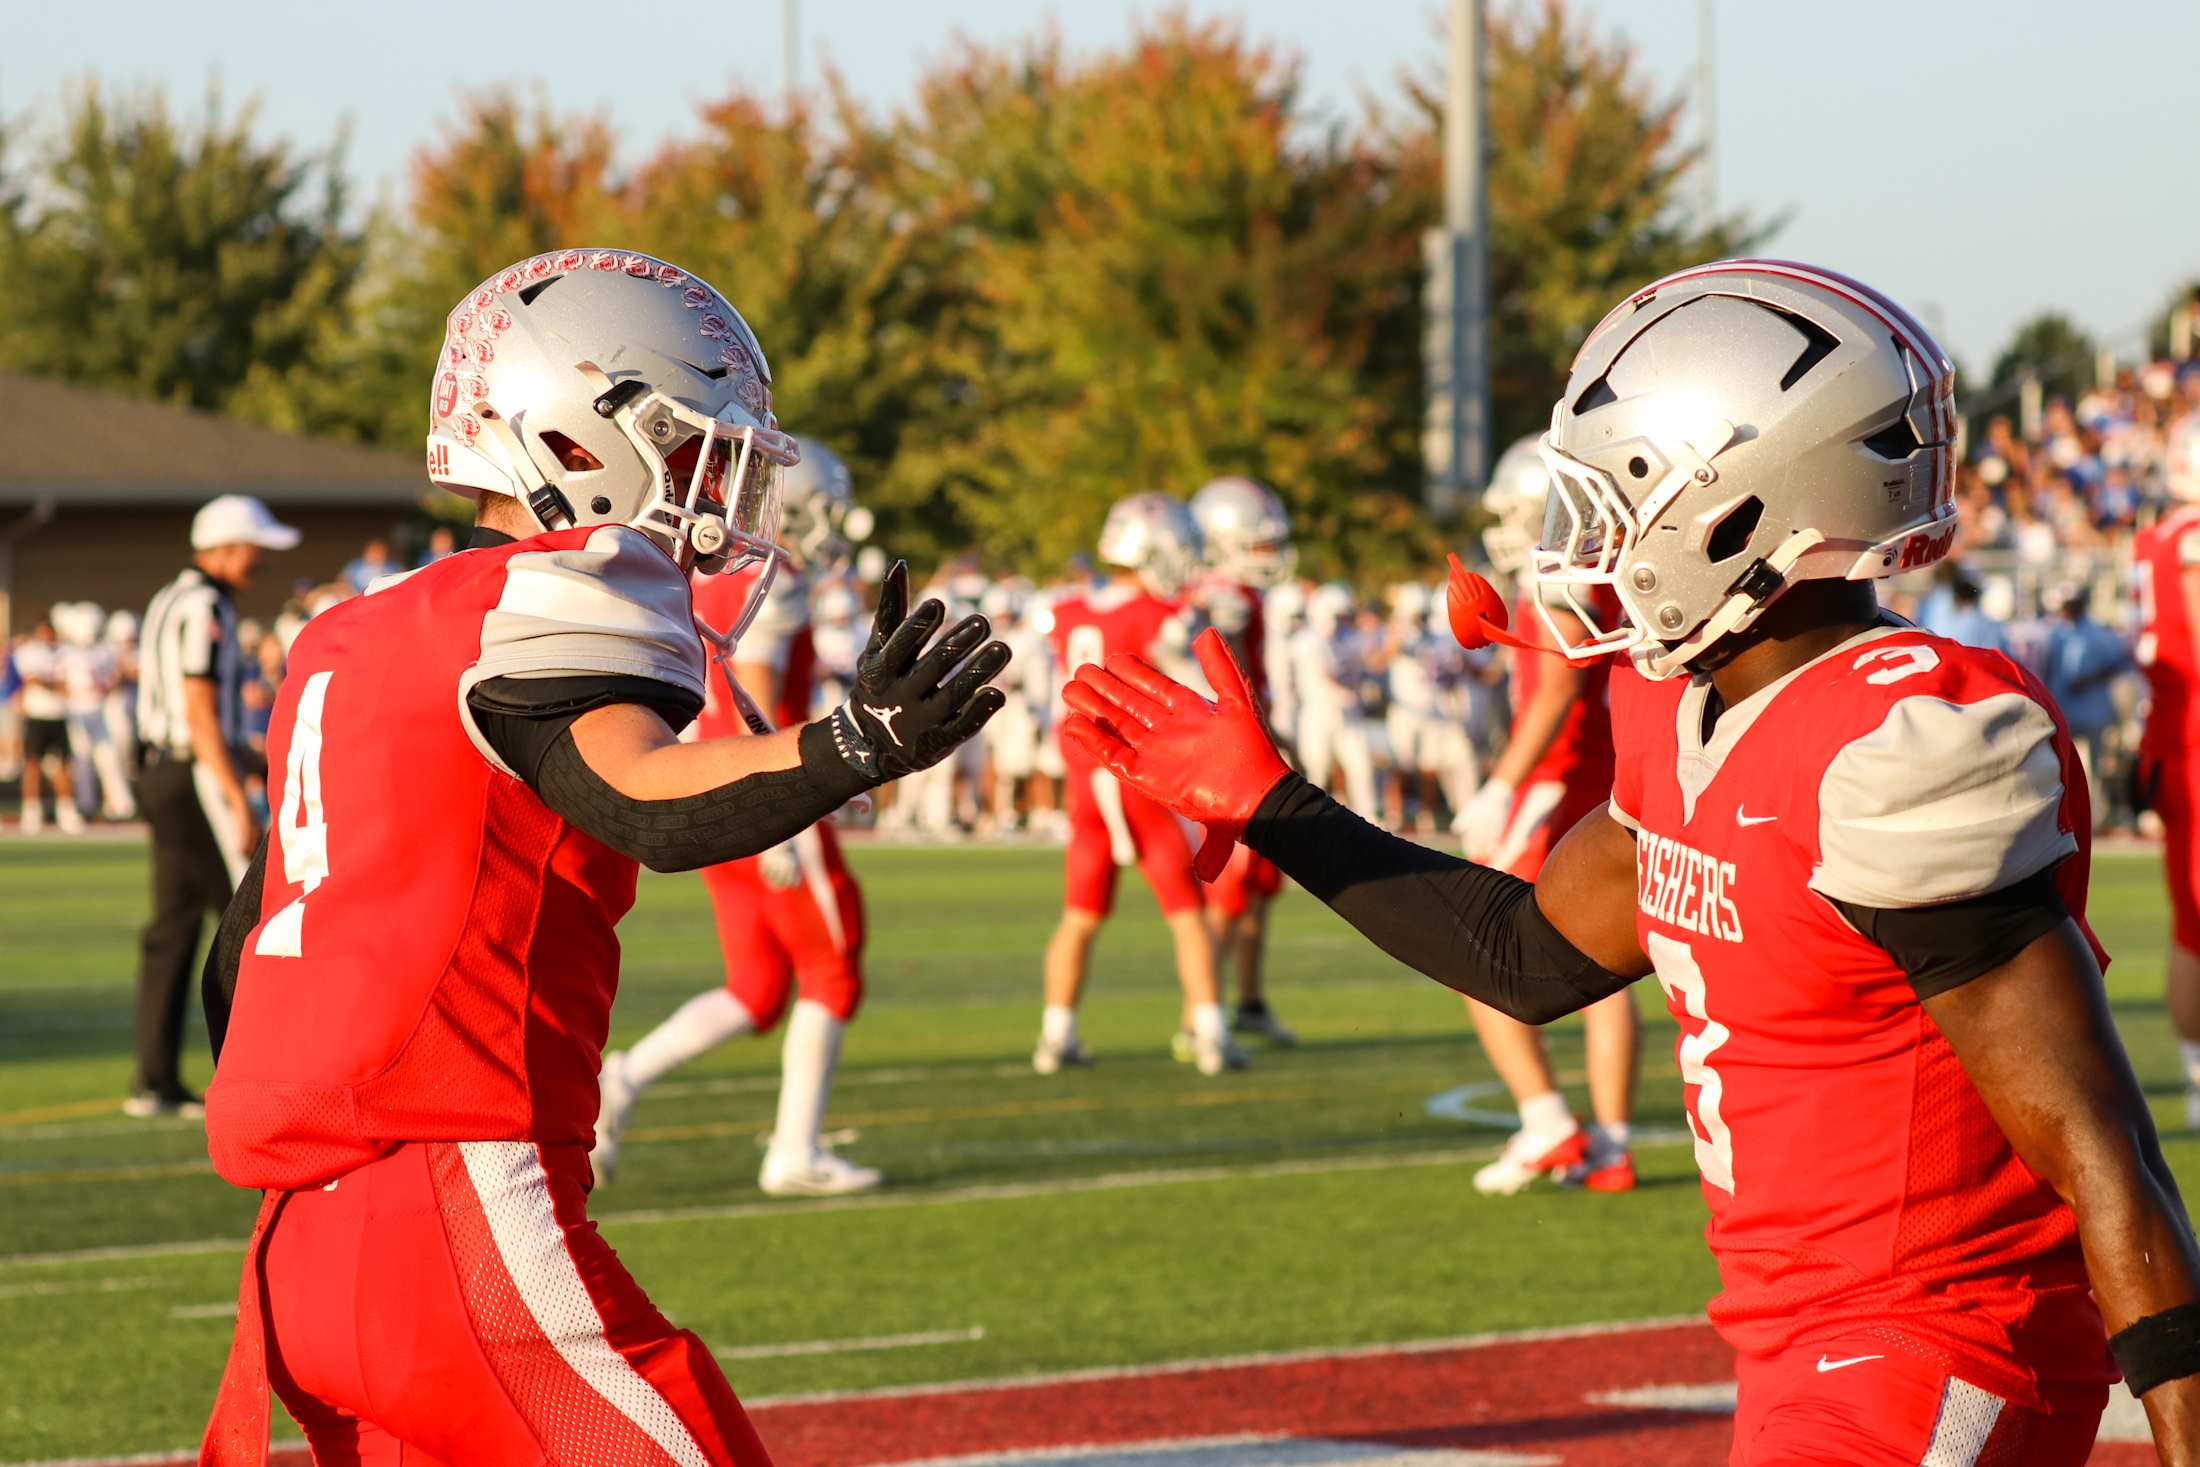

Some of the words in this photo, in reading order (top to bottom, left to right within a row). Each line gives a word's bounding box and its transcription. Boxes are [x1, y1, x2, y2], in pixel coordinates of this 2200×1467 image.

[1853, 645, 1940, 685] 3
[255, 671, 335, 957] 4
[1637, 826, 1744, 943] FISHERS
[1648, 931, 1735, 1198] 3
